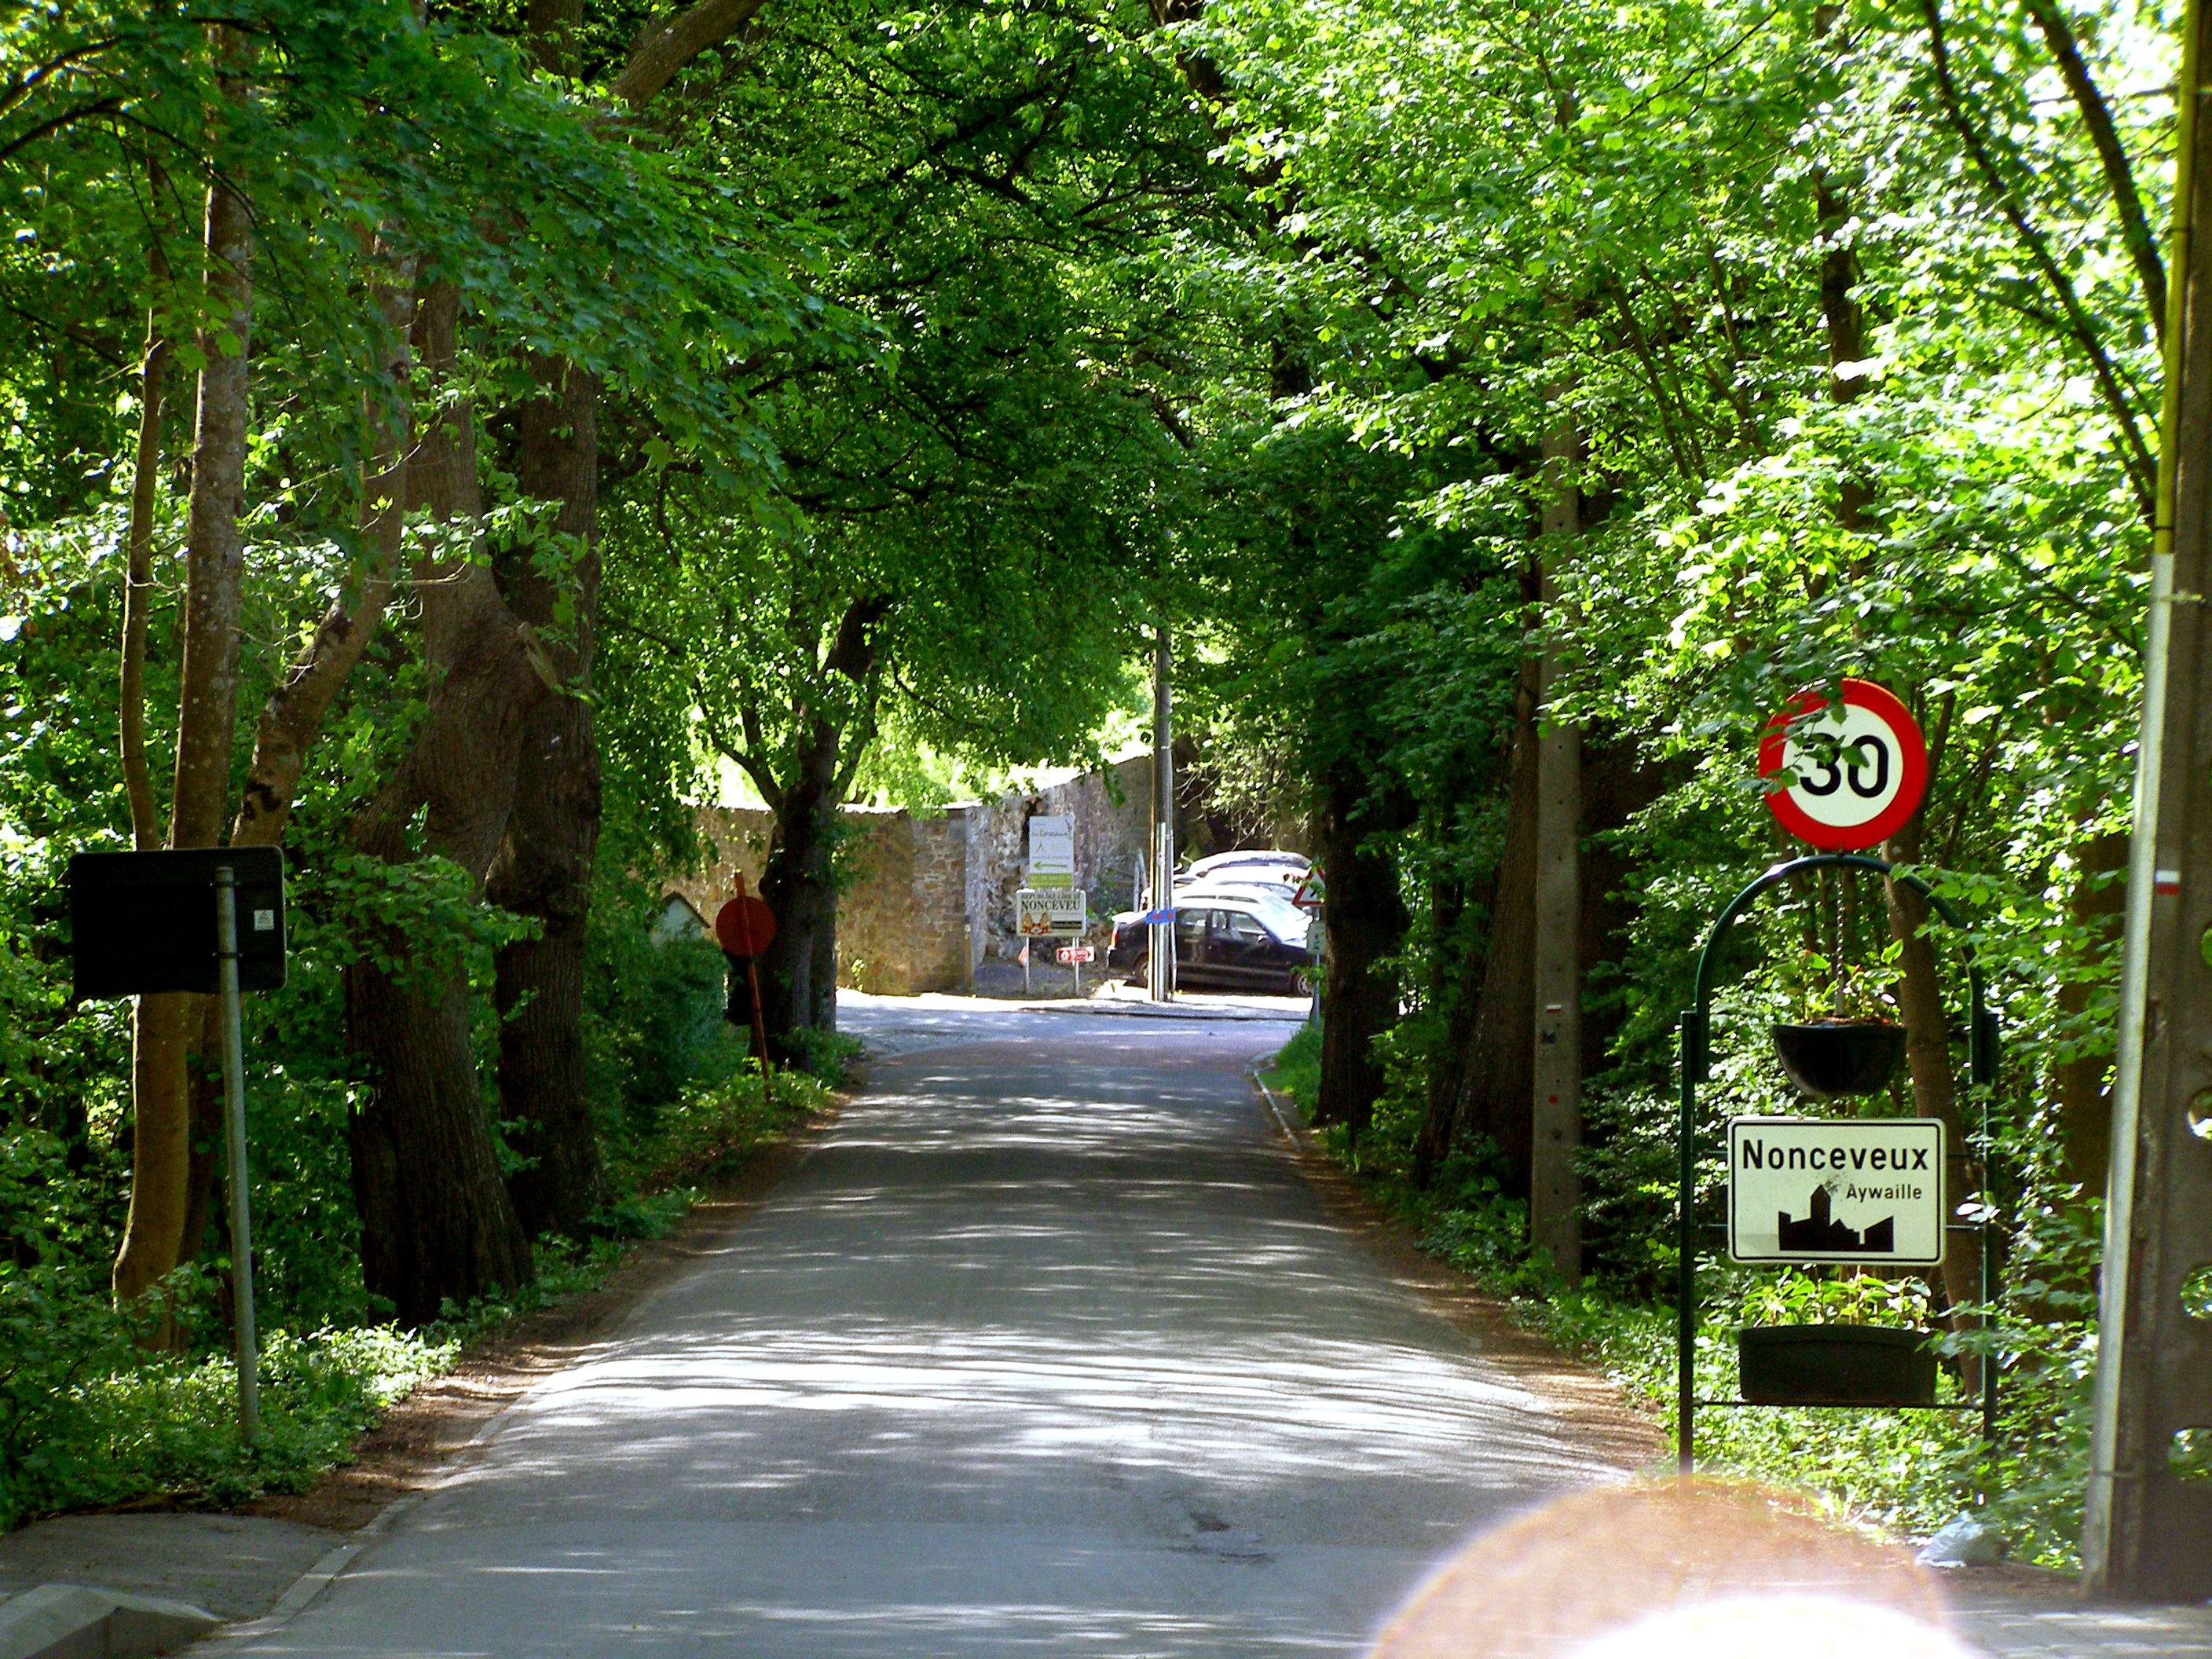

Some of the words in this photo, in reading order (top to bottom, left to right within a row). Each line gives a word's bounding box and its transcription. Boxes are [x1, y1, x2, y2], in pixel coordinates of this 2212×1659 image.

[1800, 733, 1888, 798] 30
[1742, 1139, 1928, 1170] Nonceveux
[1846, 1184, 1922, 1203] Aywaille
